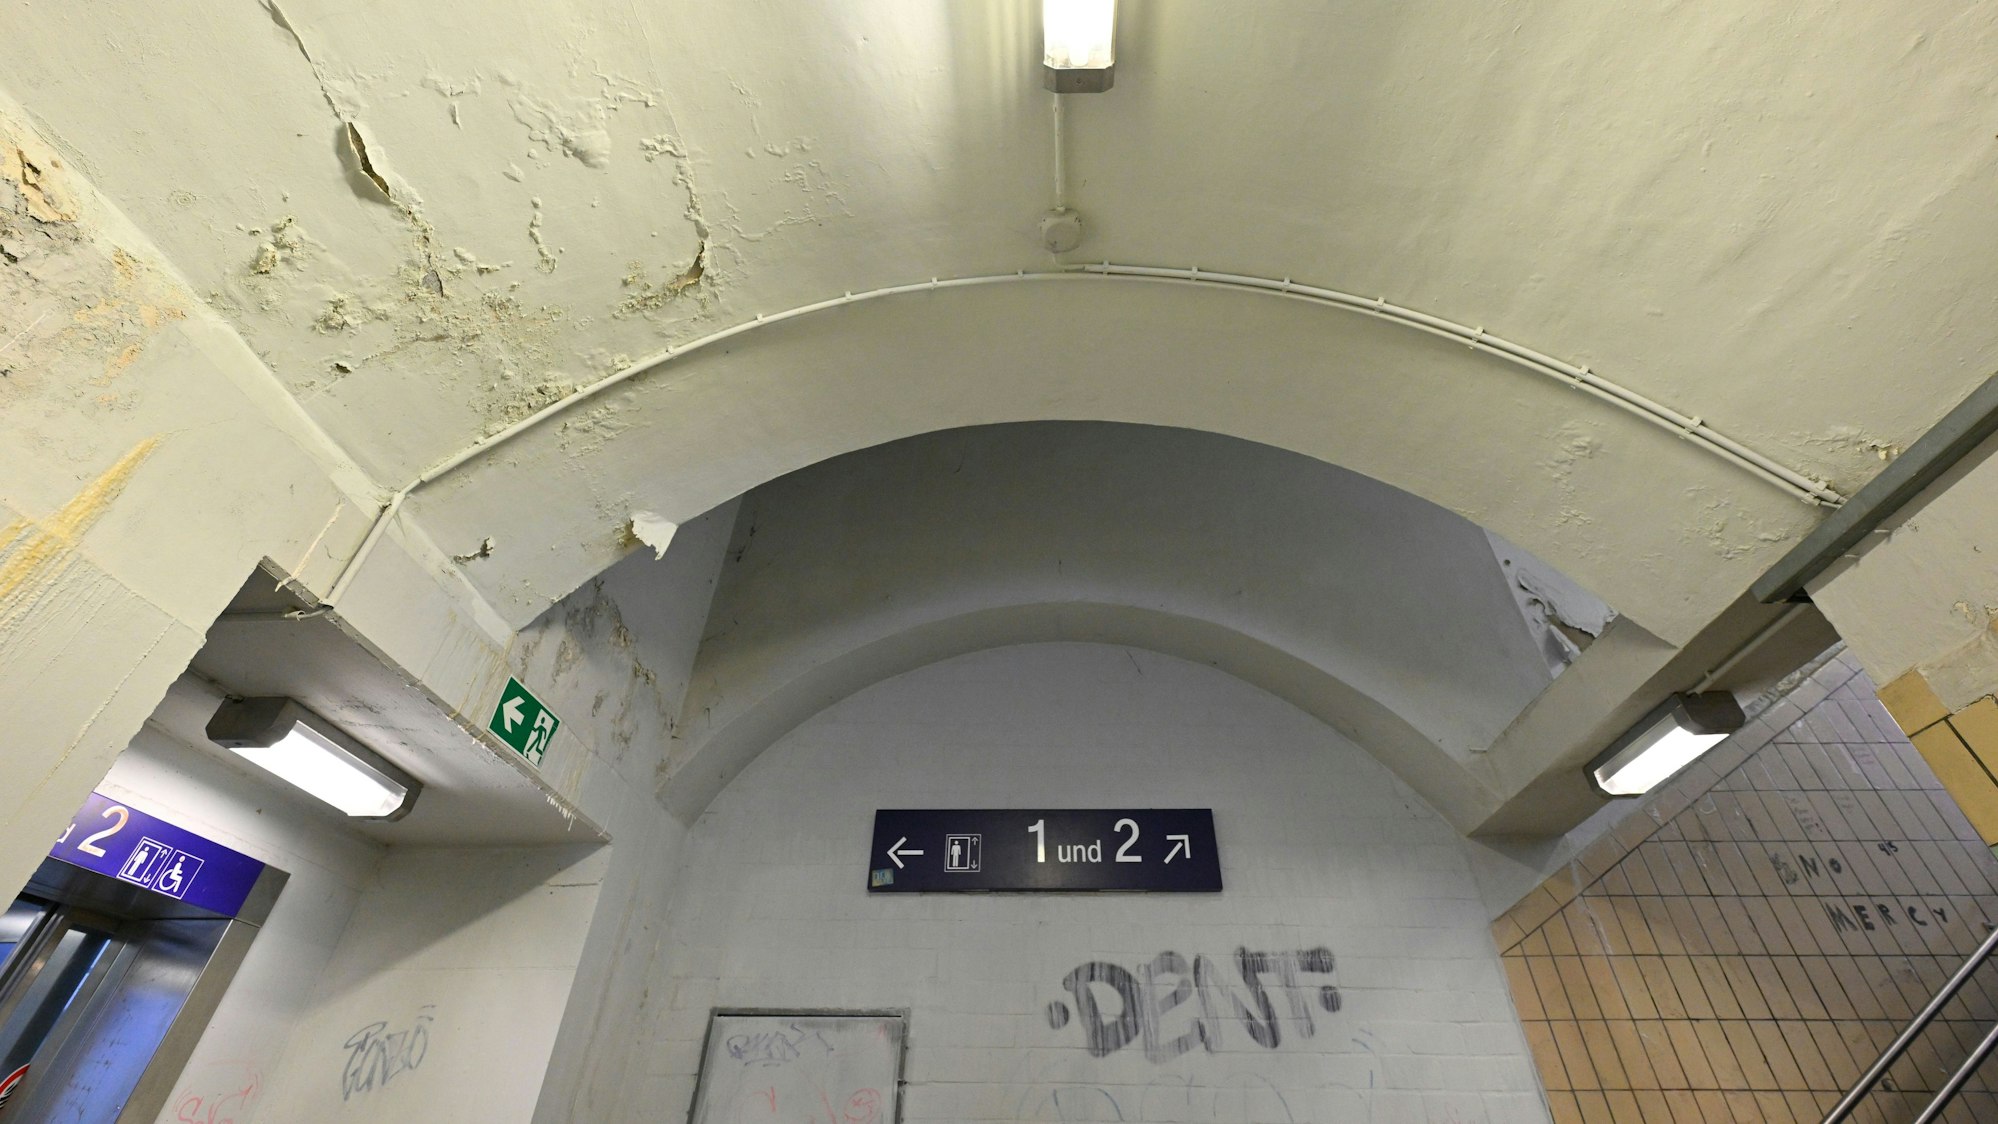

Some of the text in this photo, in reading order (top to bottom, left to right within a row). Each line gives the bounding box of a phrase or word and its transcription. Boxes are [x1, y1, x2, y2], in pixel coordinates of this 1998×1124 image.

[77, 805, 129, 858] 2
[1027, 818, 1142, 863] 1 und 2
[1825, 903, 1948, 933] MERCY
